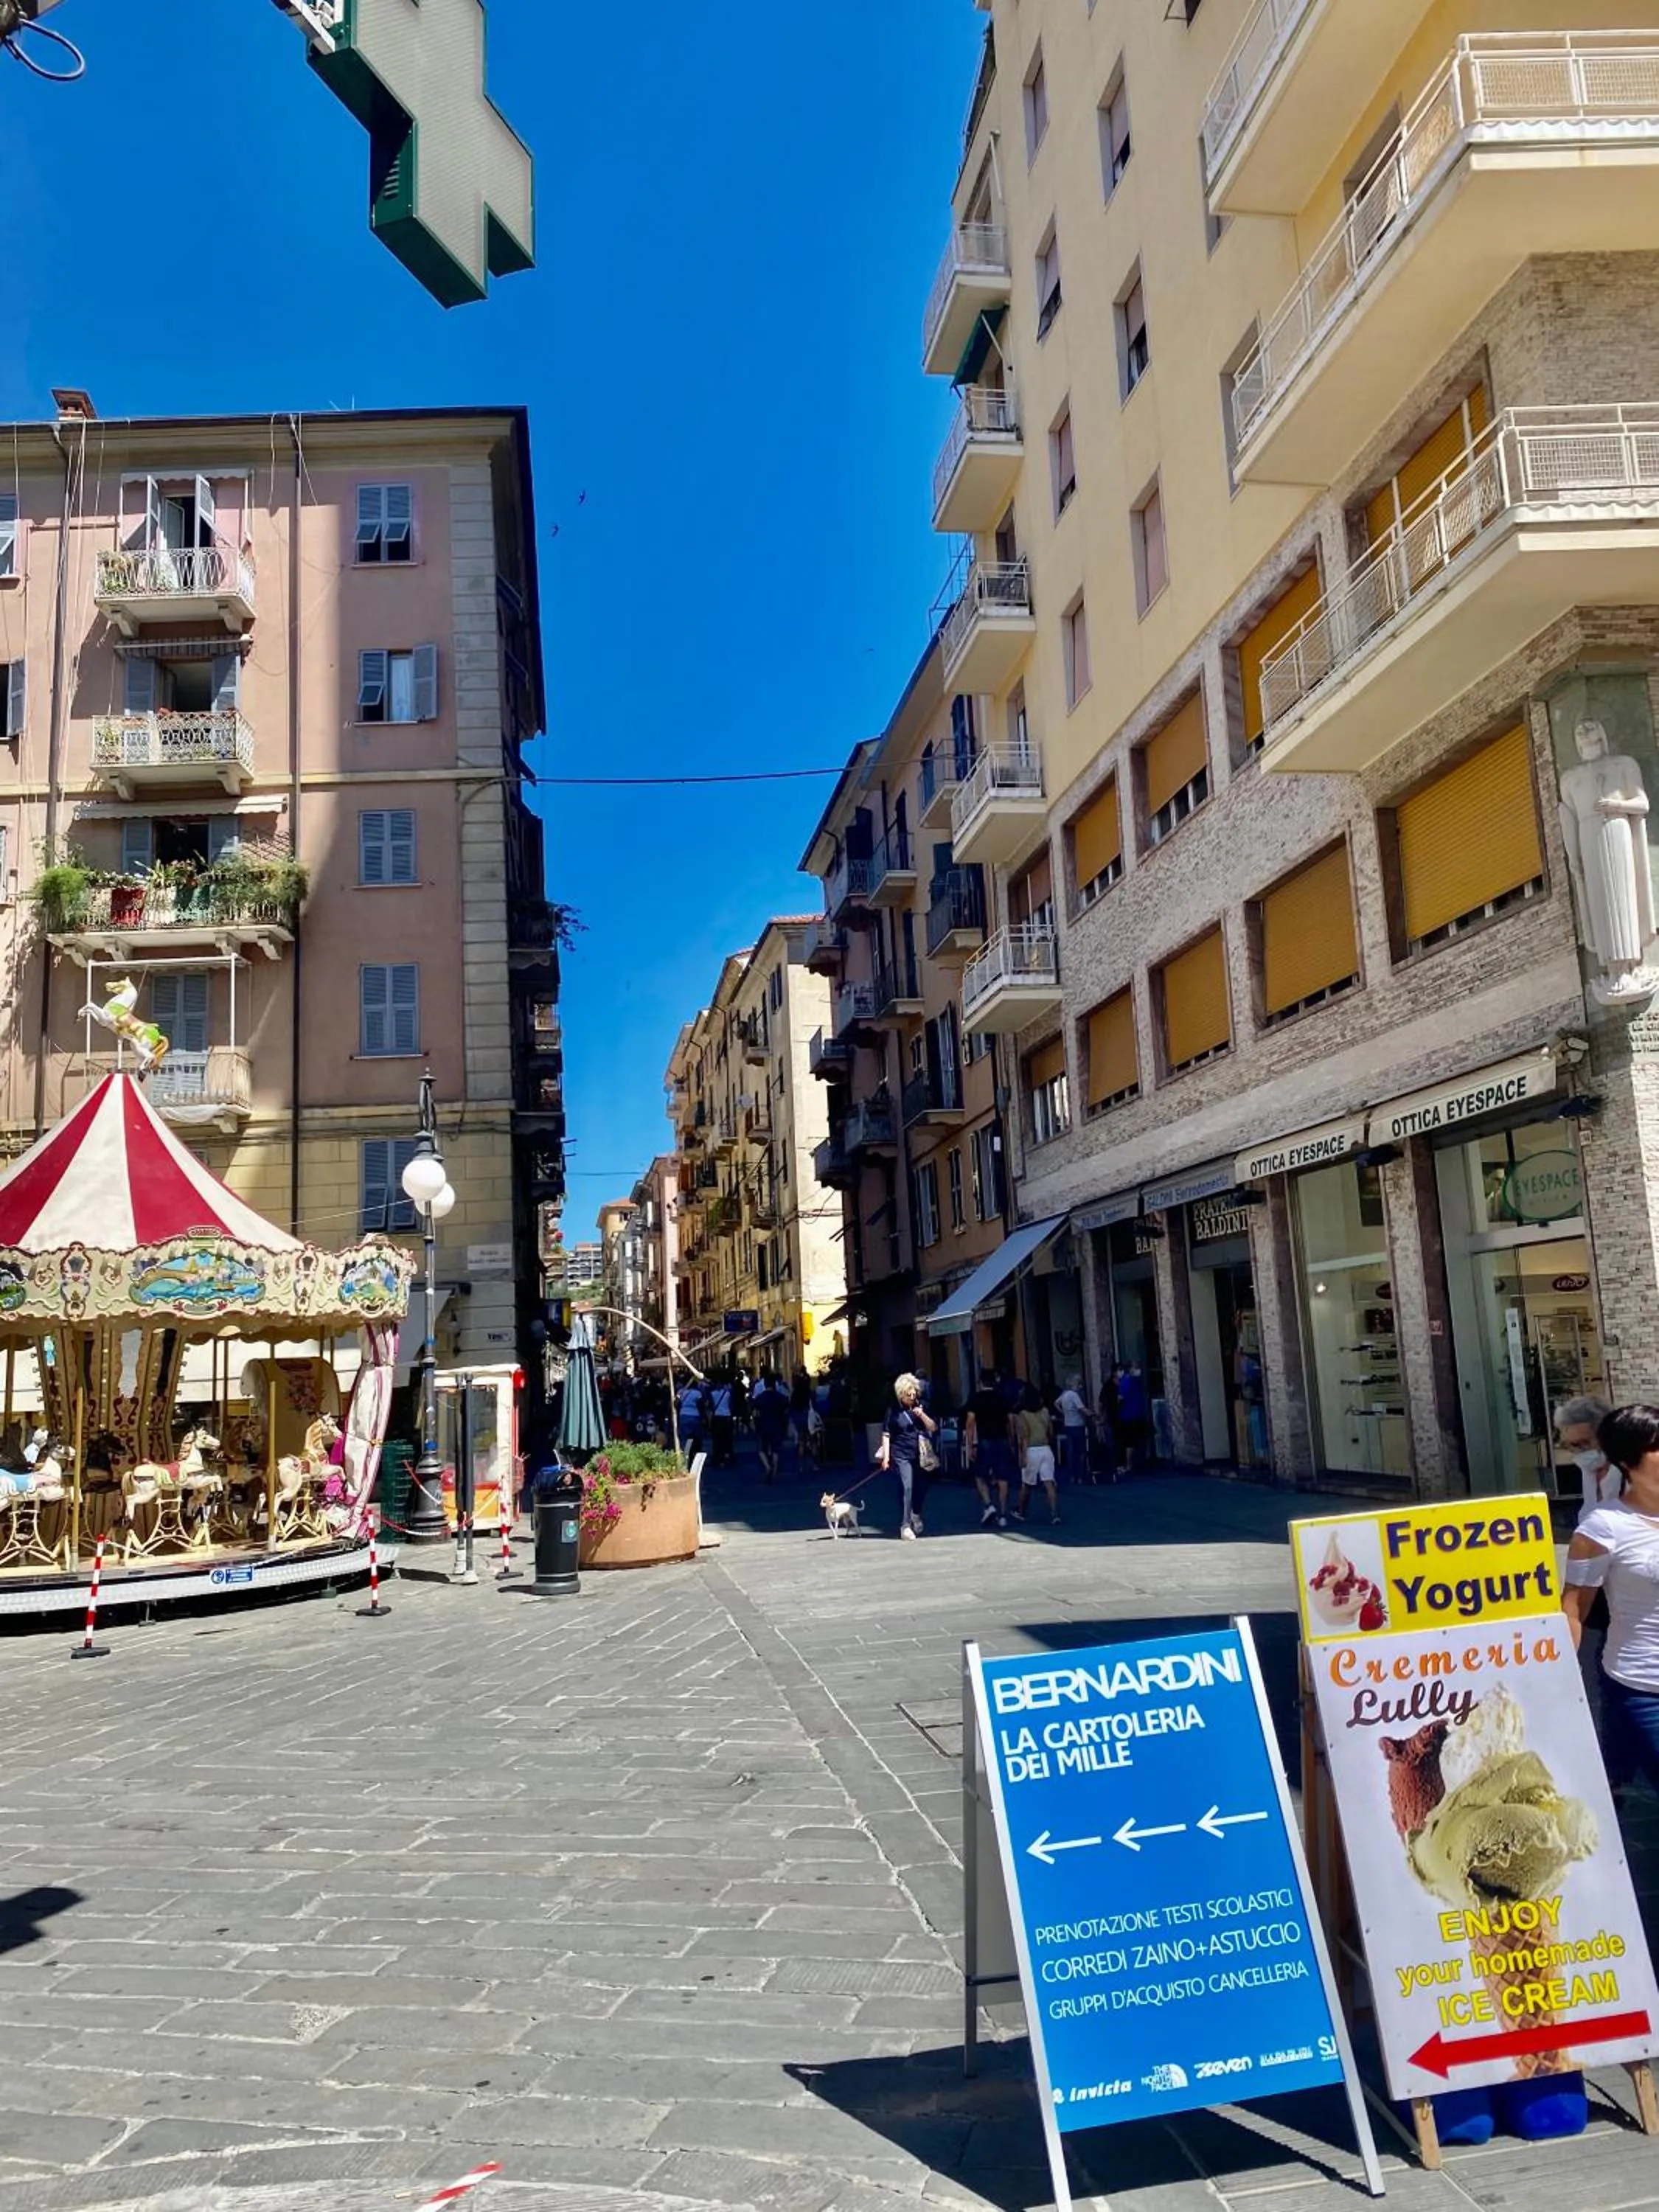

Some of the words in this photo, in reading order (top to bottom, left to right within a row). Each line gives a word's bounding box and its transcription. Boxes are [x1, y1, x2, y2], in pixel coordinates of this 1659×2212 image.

[1391, 1105, 1441, 1138] OTTICA
[1447, 1076, 1527, 1121] EYESPACE
[1251, 1154, 1285, 1178] OTTICA
[1288, 1134, 1345, 1166] EYESPACE
[1514, 1168, 1578, 1197] EYESPACE
[1195, 1210, 1248, 1240] BALDINI
[1386, 1513, 1544, 1559] Frozen
[1392, 1562, 1553, 1617] Yogurt
[992, 1648, 1242, 1714] BERNARDINI
[1329, 1632, 1560, 1688] Cremeria
[1001, 1728, 1038, 1756] LA
[1043, 1704, 1206, 1750] CARTOLERIA
[1346, 1680, 1479, 1729] Lully
[1005, 1752, 1050, 1783] DEI
[1057, 1741, 1133, 1775] MILLE
[1035, 1909, 1161, 1946] PRENOTAZIONE
[1162, 1902, 1204, 1926] TESTI
[1208, 1888, 1294, 1919] SCOLASTICI
[1438, 1895, 1563, 1944] ENJOY
[1041, 1949, 1127, 1983] CORREDI
[1131, 1921, 1301, 1969] ZAINO+ASTUCCIO
[1396, 1958, 1463, 1997] your
[1470, 1929, 1626, 1979] homemade
[1049, 1993, 1108, 2020] GRUPPI
[1112, 1977, 1205, 2010] D'ACQUISTO
[1208, 1959, 1310, 1994] CANCELLERIA
[1437, 1989, 1495, 2028] ICE
[1501, 1969, 1620, 2017] CREAM
[1069, 2079, 1132, 2102] invicta
[1152, 2064, 1170, 2076] THE
